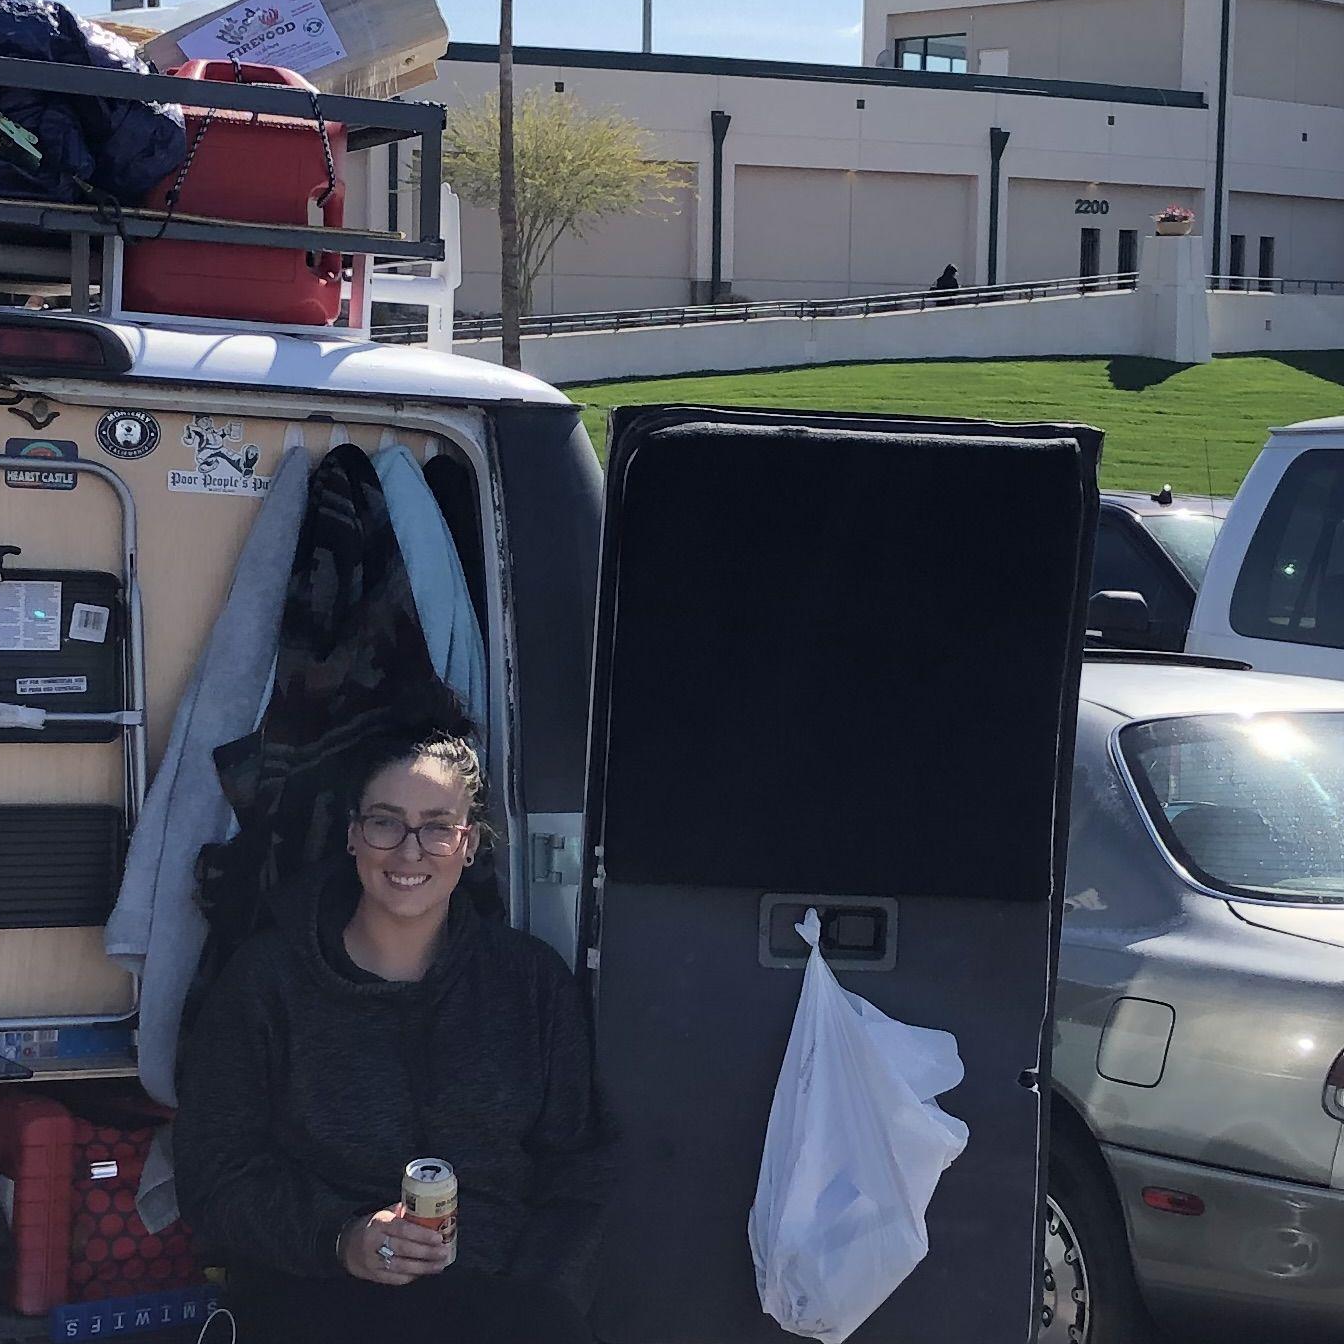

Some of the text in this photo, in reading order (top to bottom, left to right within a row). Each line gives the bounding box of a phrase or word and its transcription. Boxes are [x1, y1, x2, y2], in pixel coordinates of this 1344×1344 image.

[226, 21, 296, 59] FIREWOOD
[1074, 198, 1110, 215] 2200
[7, 470, 74, 484] HEARST CASTLE
[203, 474, 249, 488] People's
[252, 477, 271, 492] Pu
